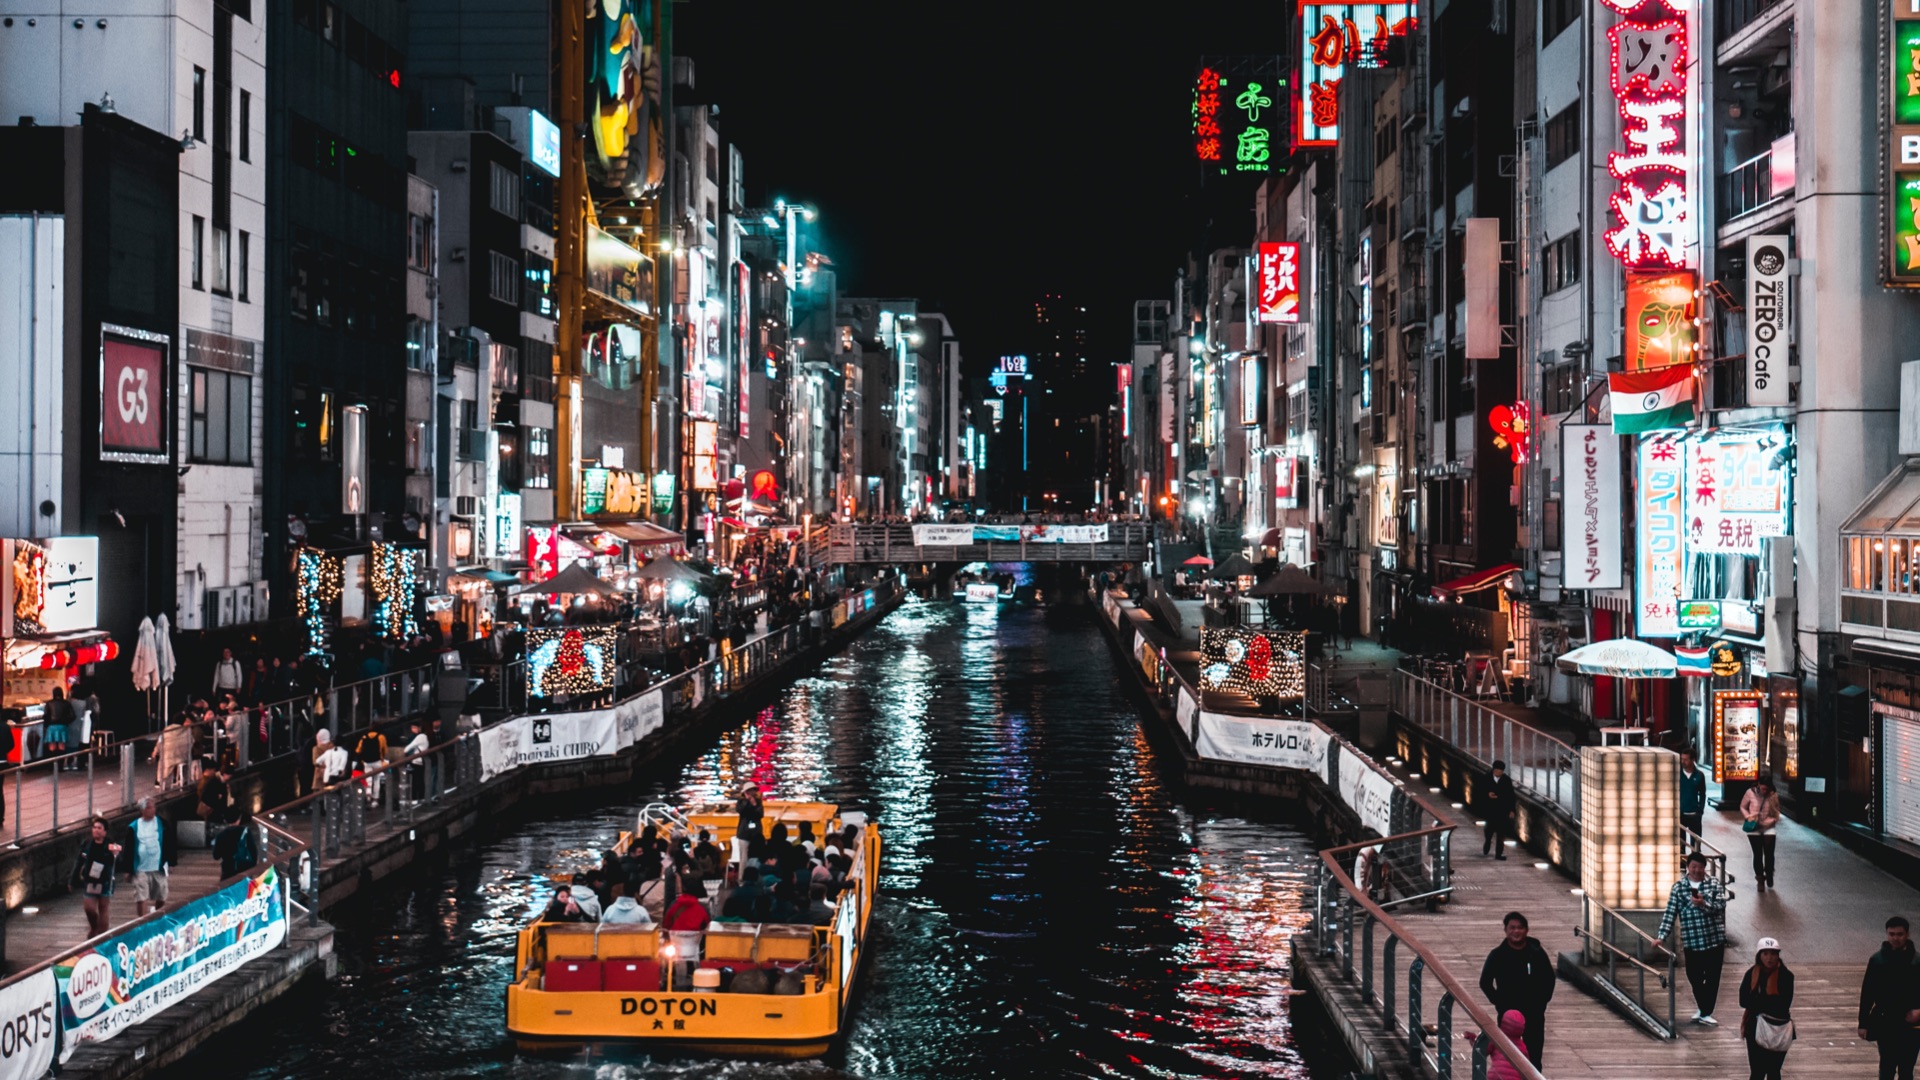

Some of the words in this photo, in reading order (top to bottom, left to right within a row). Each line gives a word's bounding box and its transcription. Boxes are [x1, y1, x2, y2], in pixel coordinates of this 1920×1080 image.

[1236, 83, 1271, 161] 千房
[1606, 0, 1687, 265] 阪王将
[1277, 246, 1295, 291] ツルハ
[1755, 280, 1777, 344] ZERO
[117, 365, 148, 424] G3
[1717, 518, 1753, 548] 免税
[72, 962, 107, 997] WAON
[620, 997, 716, 1016] DOTON
[0, 1001, 52, 1059] ORTS
